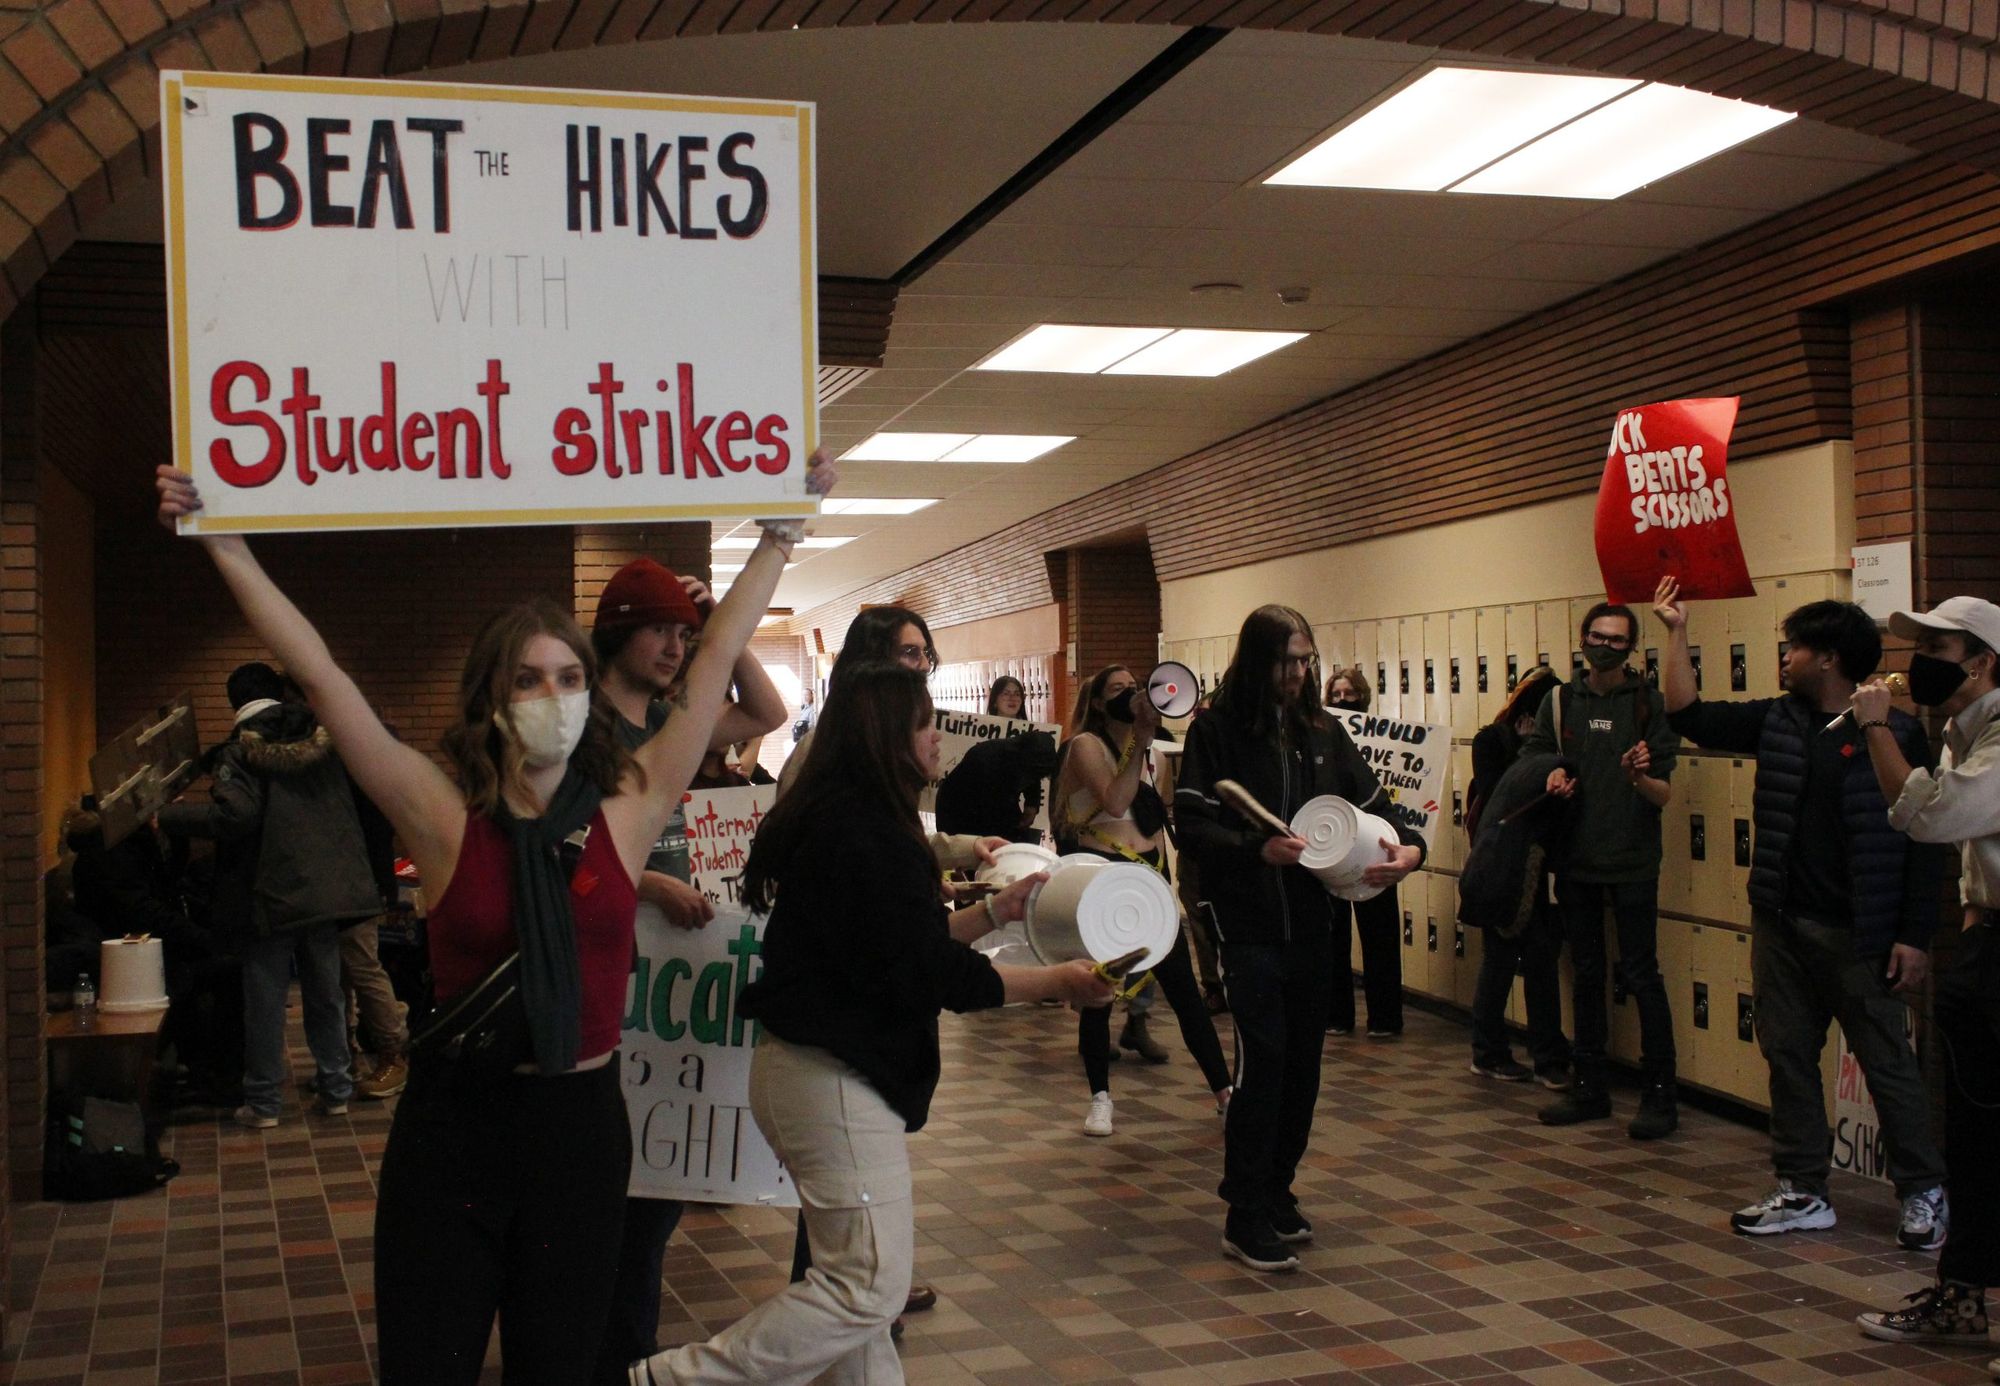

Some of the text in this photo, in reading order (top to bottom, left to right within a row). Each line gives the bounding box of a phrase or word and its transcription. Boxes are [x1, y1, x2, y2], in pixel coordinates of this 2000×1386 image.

[232, 112, 770, 240] BEAT THE HIKES
[422, 252, 569, 331] WITH
[208, 358, 791, 488] Student strikes
[1624, 444, 1708, 494] BEATS
[1630, 478, 1729, 534] SCISSORS
[1857, 558, 1865, 568] ST
[1857, 578, 1890, 588] Classroom
[935, 710, 1001, 739] Tuition
[1348, 714, 1427, 745] SHOULD
[1588, 719, 1613, 731] VANS
[1356, 744, 1424, 773] AVE TO
[1374, 768, 1423, 791] ETWEEN
[678, 1053, 704, 1093] a
